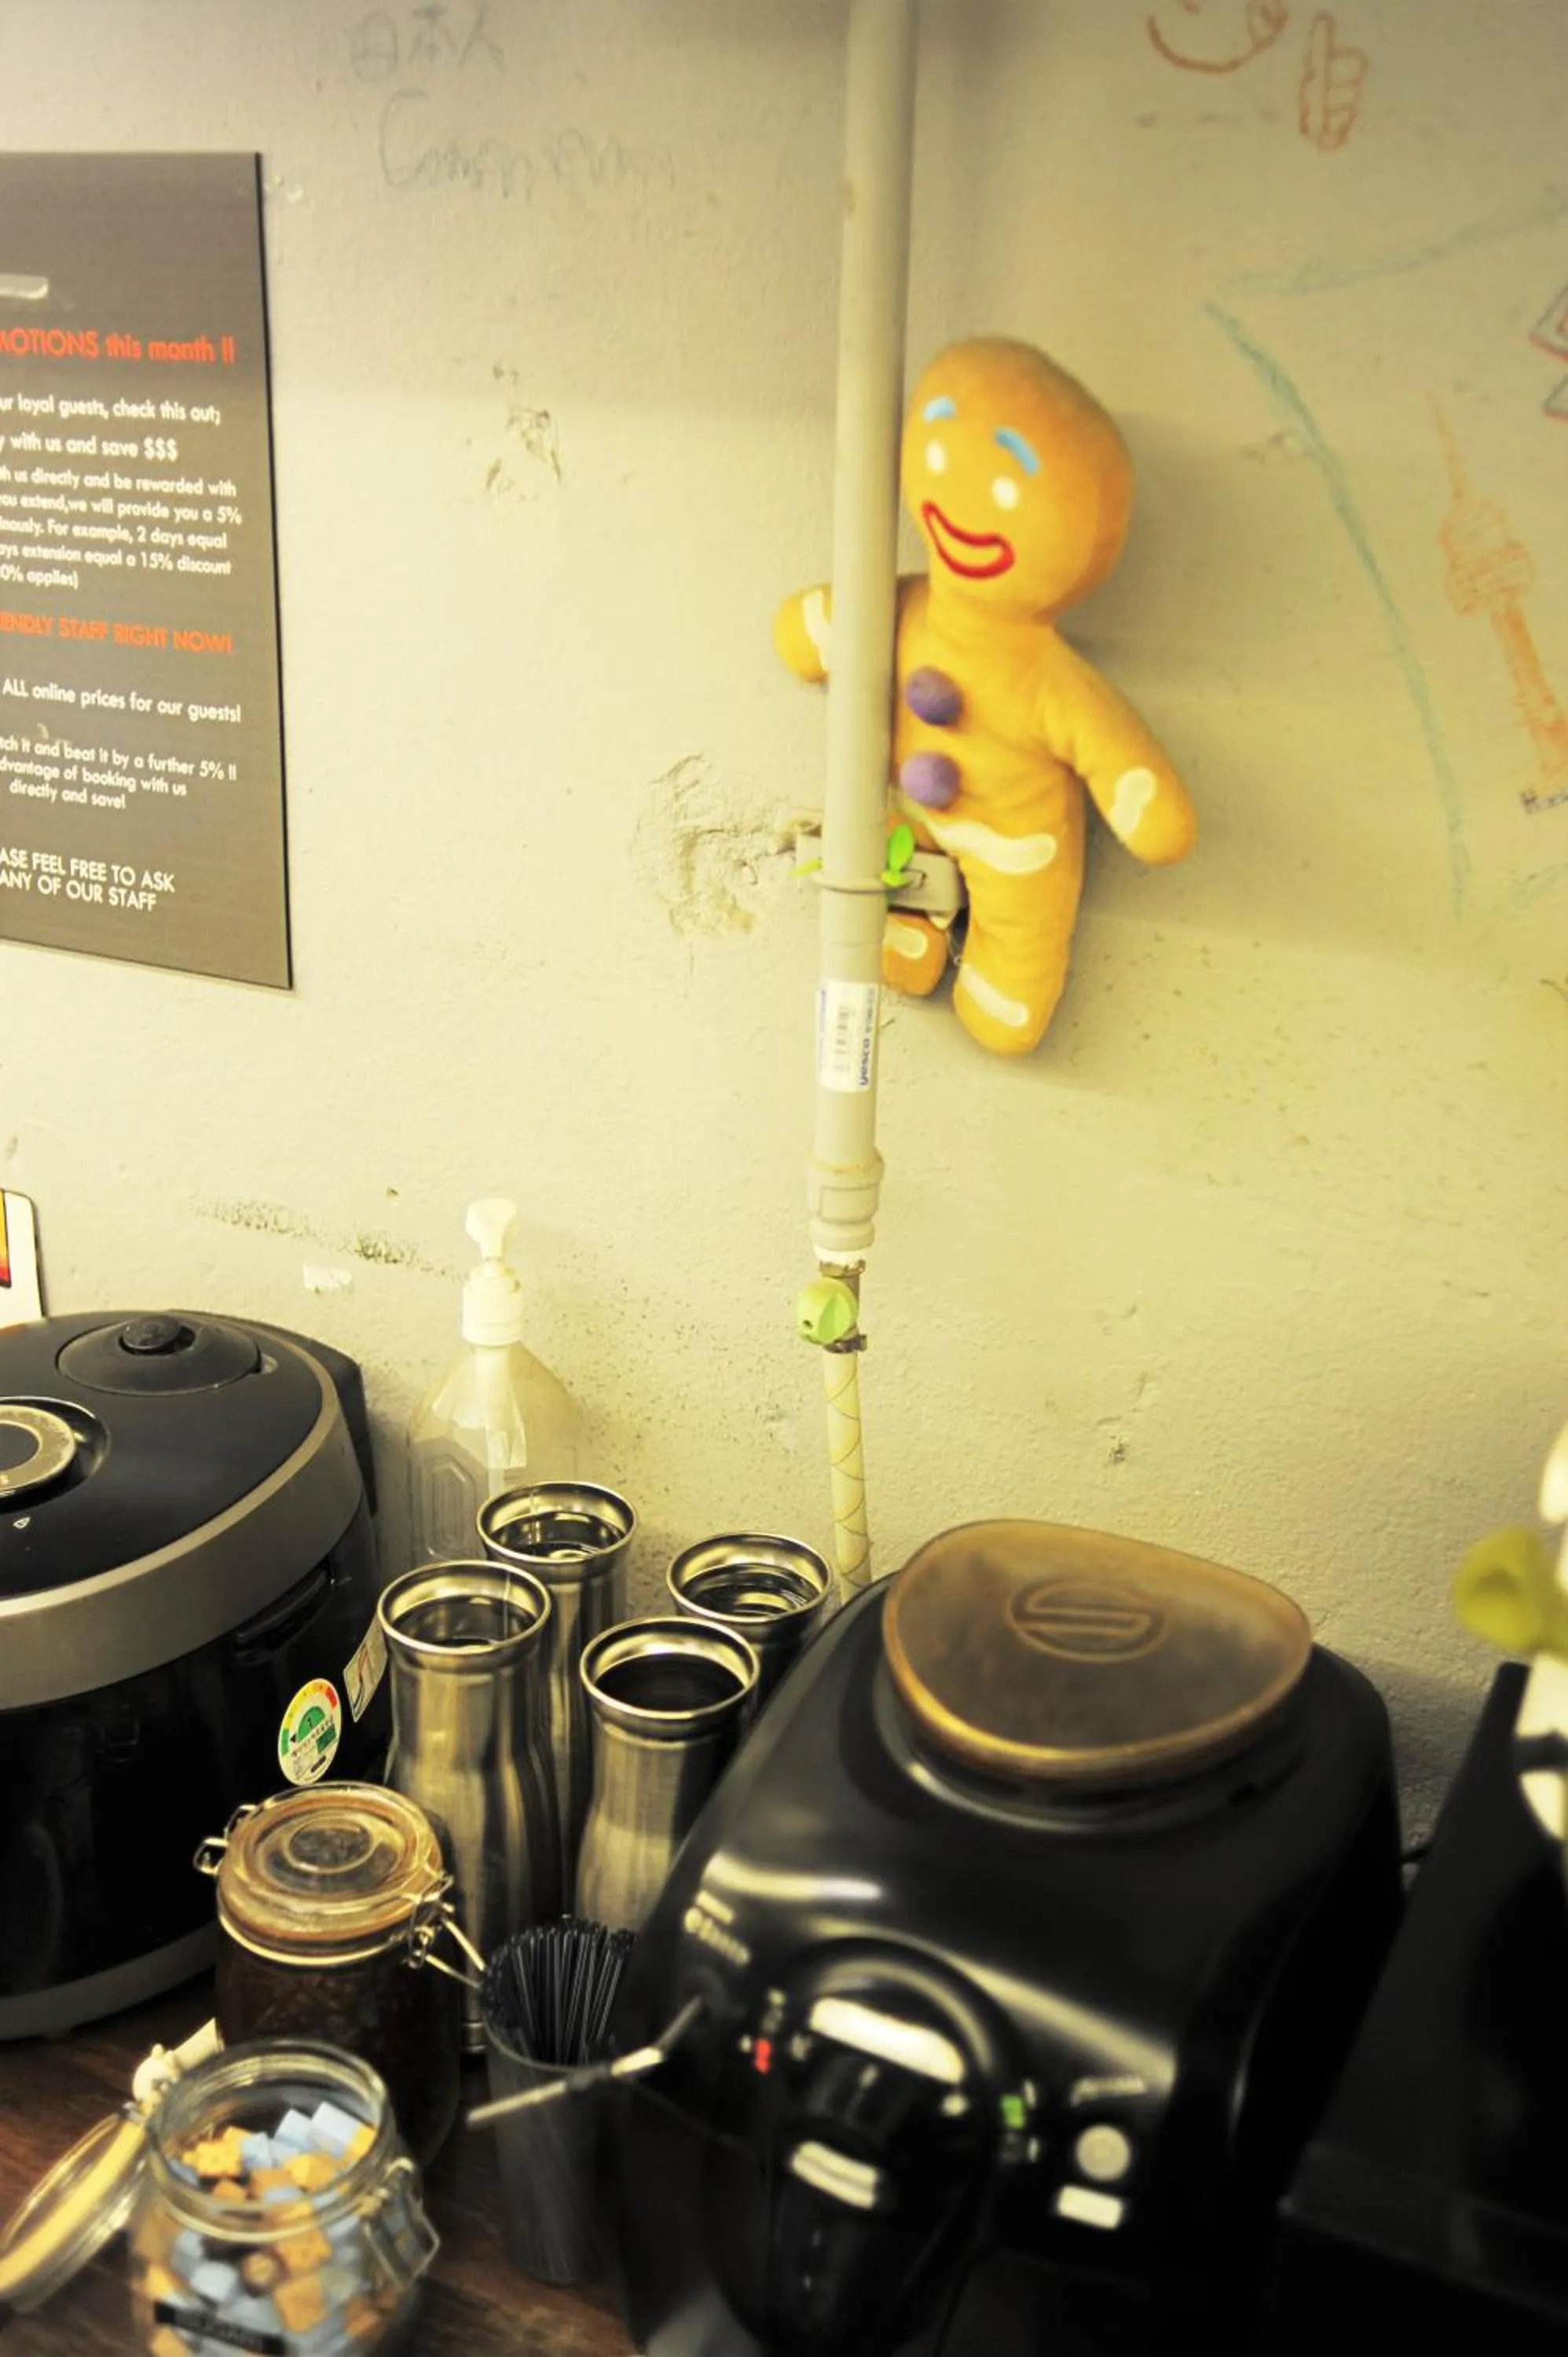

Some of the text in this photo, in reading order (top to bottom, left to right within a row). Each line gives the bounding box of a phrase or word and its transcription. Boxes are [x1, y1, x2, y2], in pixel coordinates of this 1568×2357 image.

[105, 332, 142, 360] this
[148, 335, 215, 363] month
[17, 394, 54, 416] loyal
[112, 398, 156, 419] check
[159, 400, 185, 420] this
[10, 432, 41, 452] with
[45, 438, 62, 452] us
[66, 434, 97, 454] and
[101, 441, 138, 457] save
[144, 437, 178, 461] $$$
[14, 471, 27, 483] us
[31, 469, 79, 489] directly
[83, 472, 110, 488] and
[114, 473, 132, 489] be
[136, 478, 203, 495] rewarded
[208, 479, 236, 497] with
[92, 497, 113, 514] will
[118, 501, 169, 519] provide
[174, 508, 198, 523] you
[203, 510, 212, 522] a
[217, 506, 242, 525] 5%
[48, 519, 68, 536] For
[72, 525, 133, 544] example,
[137, 526, 146, 543] 2
[150, 528, 184, 548] days
[188, 533, 226, 550] equal
[22, 545, 81, 562] extension
[84, 548, 122, 566] equal
[126, 555, 136, 566] a
[140, 552, 173, 571] 15%
[177, 555, 232, 574] discount
[58, 616, 108, 641] STAFF
[114, 623, 168, 648] RIGHT
[2, 678, 241, 723] ALL online prices for our guests!
[21, 738, 30, 753] it
[35, 741, 60, 757] and
[64, 740, 96, 761] beat
[99, 746, 109, 764] it
[112, 748, 130, 769] by
[134, 756, 143, 767] a
[148, 754, 193, 775] further
[199, 760, 225, 780] 5%
[0, 757, 187, 796] dvantage of booking with us
[9, 780, 57, 803] directly
[61, 786, 87, 805] and
[32, 852, 66, 875] FEEL
[70, 858, 107, 882] FREE
[111, 864, 135, 887] TO
[141, 872, 176, 893] ASK
[0, 869, 157, 911] ANY OF OUR STAFF
